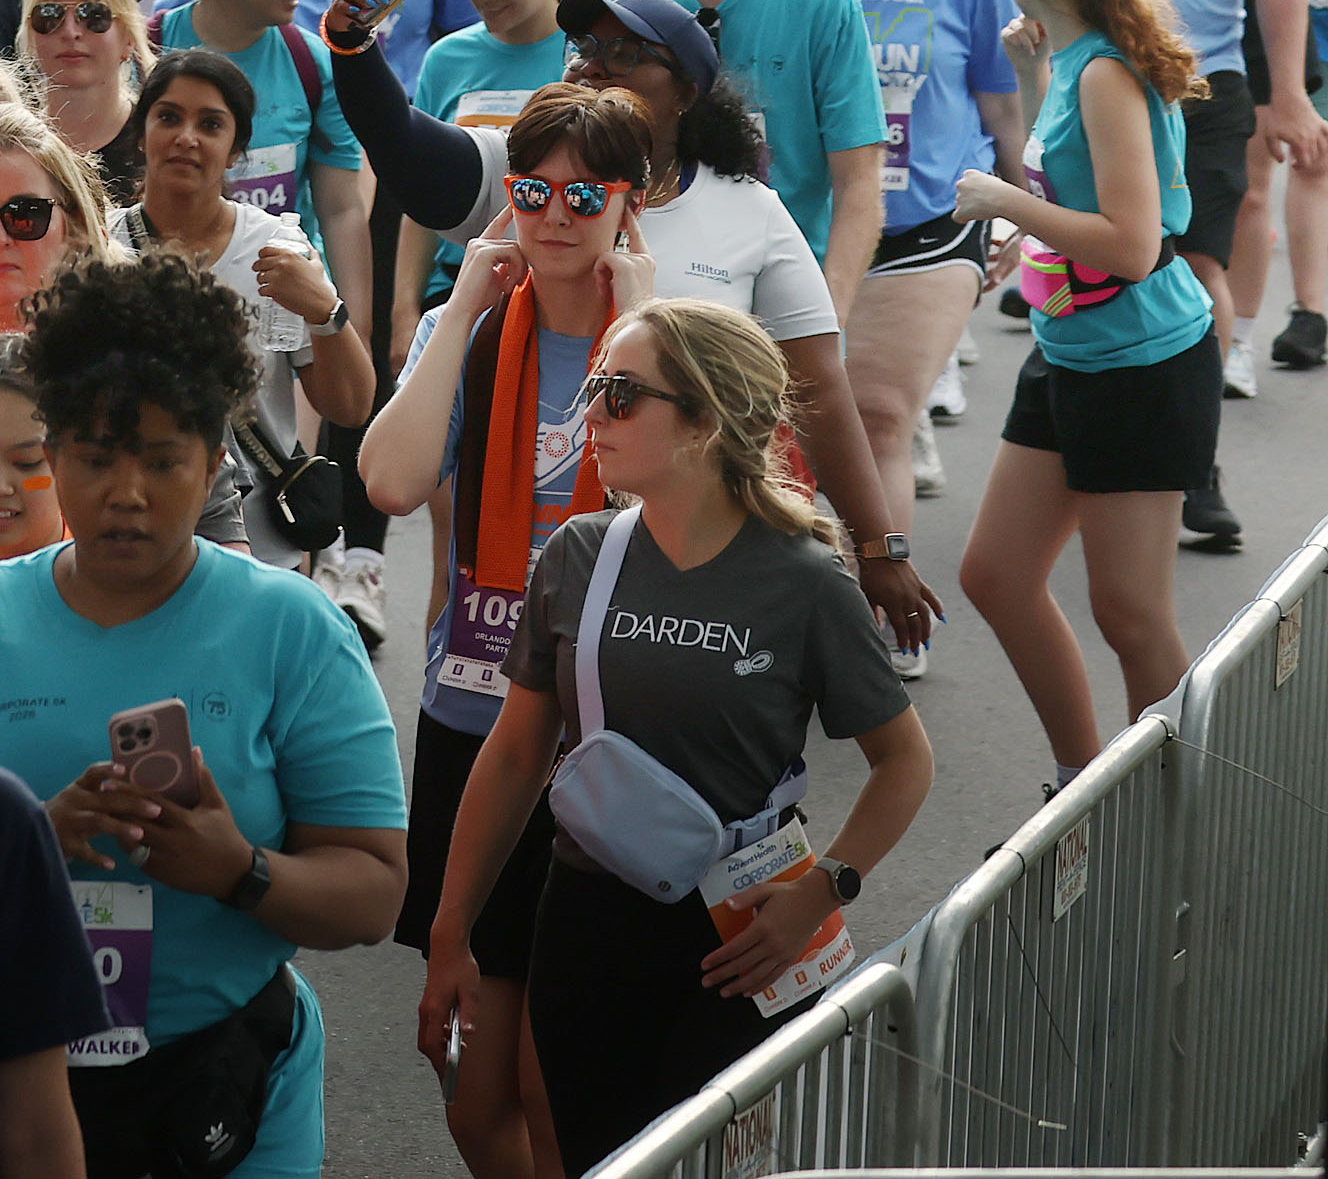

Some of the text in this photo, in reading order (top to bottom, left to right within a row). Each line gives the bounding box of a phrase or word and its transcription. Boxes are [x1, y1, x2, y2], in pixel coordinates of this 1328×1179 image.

[875, 43, 920, 73] UN
[691, 262, 729, 278] Hilton
[463, 589, 525, 629] 109
[610, 610, 751, 658] DARDEN
[818, 937, 853, 976] RUNNER
